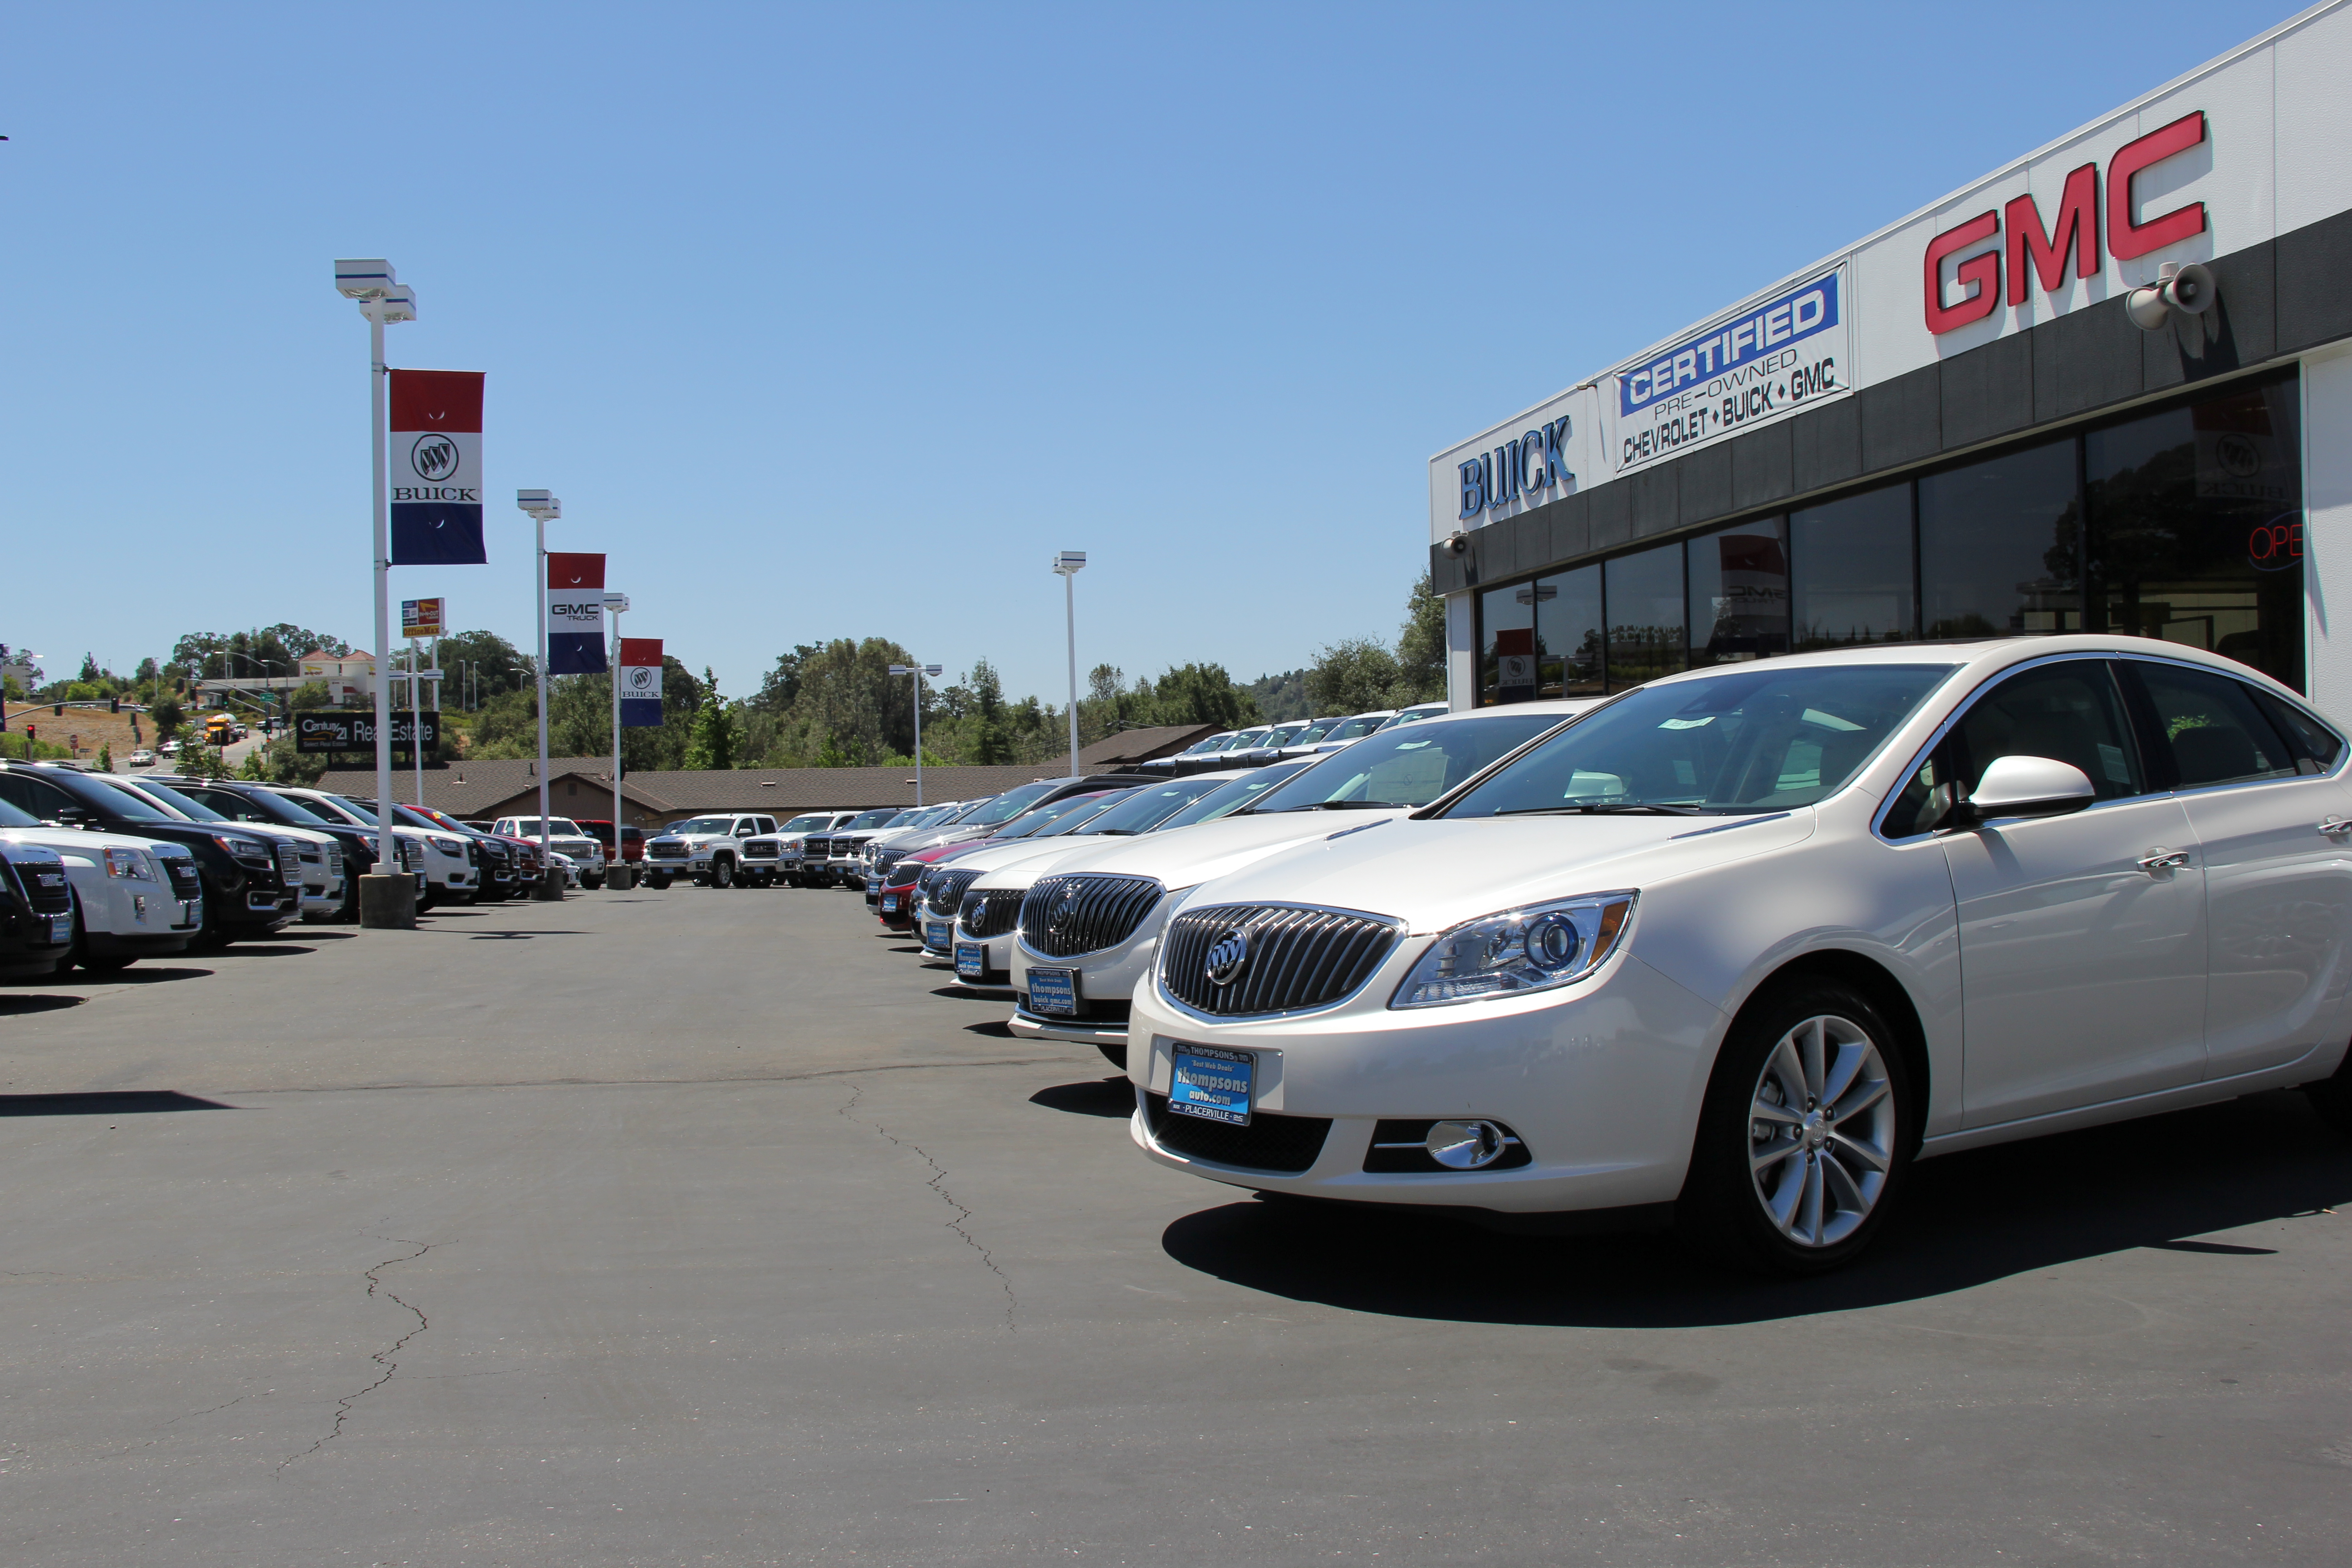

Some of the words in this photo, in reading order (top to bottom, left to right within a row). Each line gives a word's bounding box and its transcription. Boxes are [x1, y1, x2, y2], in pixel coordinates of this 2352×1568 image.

[1924, 110, 2205, 335] GMC
[1630, 289, 1824, 405] CERTIFIED
[1655, 349, 1797, 420] PRE-OWNED
[1624, 407, 1708, 463] CHEVROLET
[1723, 381, 1774, 427] BUICK
[1791, 357, 1834, 401] GMC
[1458, 415, 1575, 520] BUICK
[393, 487, 477, 501] BUICK
[2249, 524, 2304, 559] OPE
[552, 604, 599, 615] GMC
[404, 626, 440, 636] OfficeMax
[302, 719, 340, 732] Century
[336, 727, 347, 740] 21
[354, 720, 377, 741] Rea
[1032, 982, 1071, 996] thompsons
[1191, 1046, 1234, 1060] THOMPSONS
[1205, 1062, 1216, 1070] Web
[1177, 1067, 1248, 1093] thompsons
[1189, 1090, 1231, 1106] auto.com
[1185, 1104, 1229, 1120] PLACERVILLE
